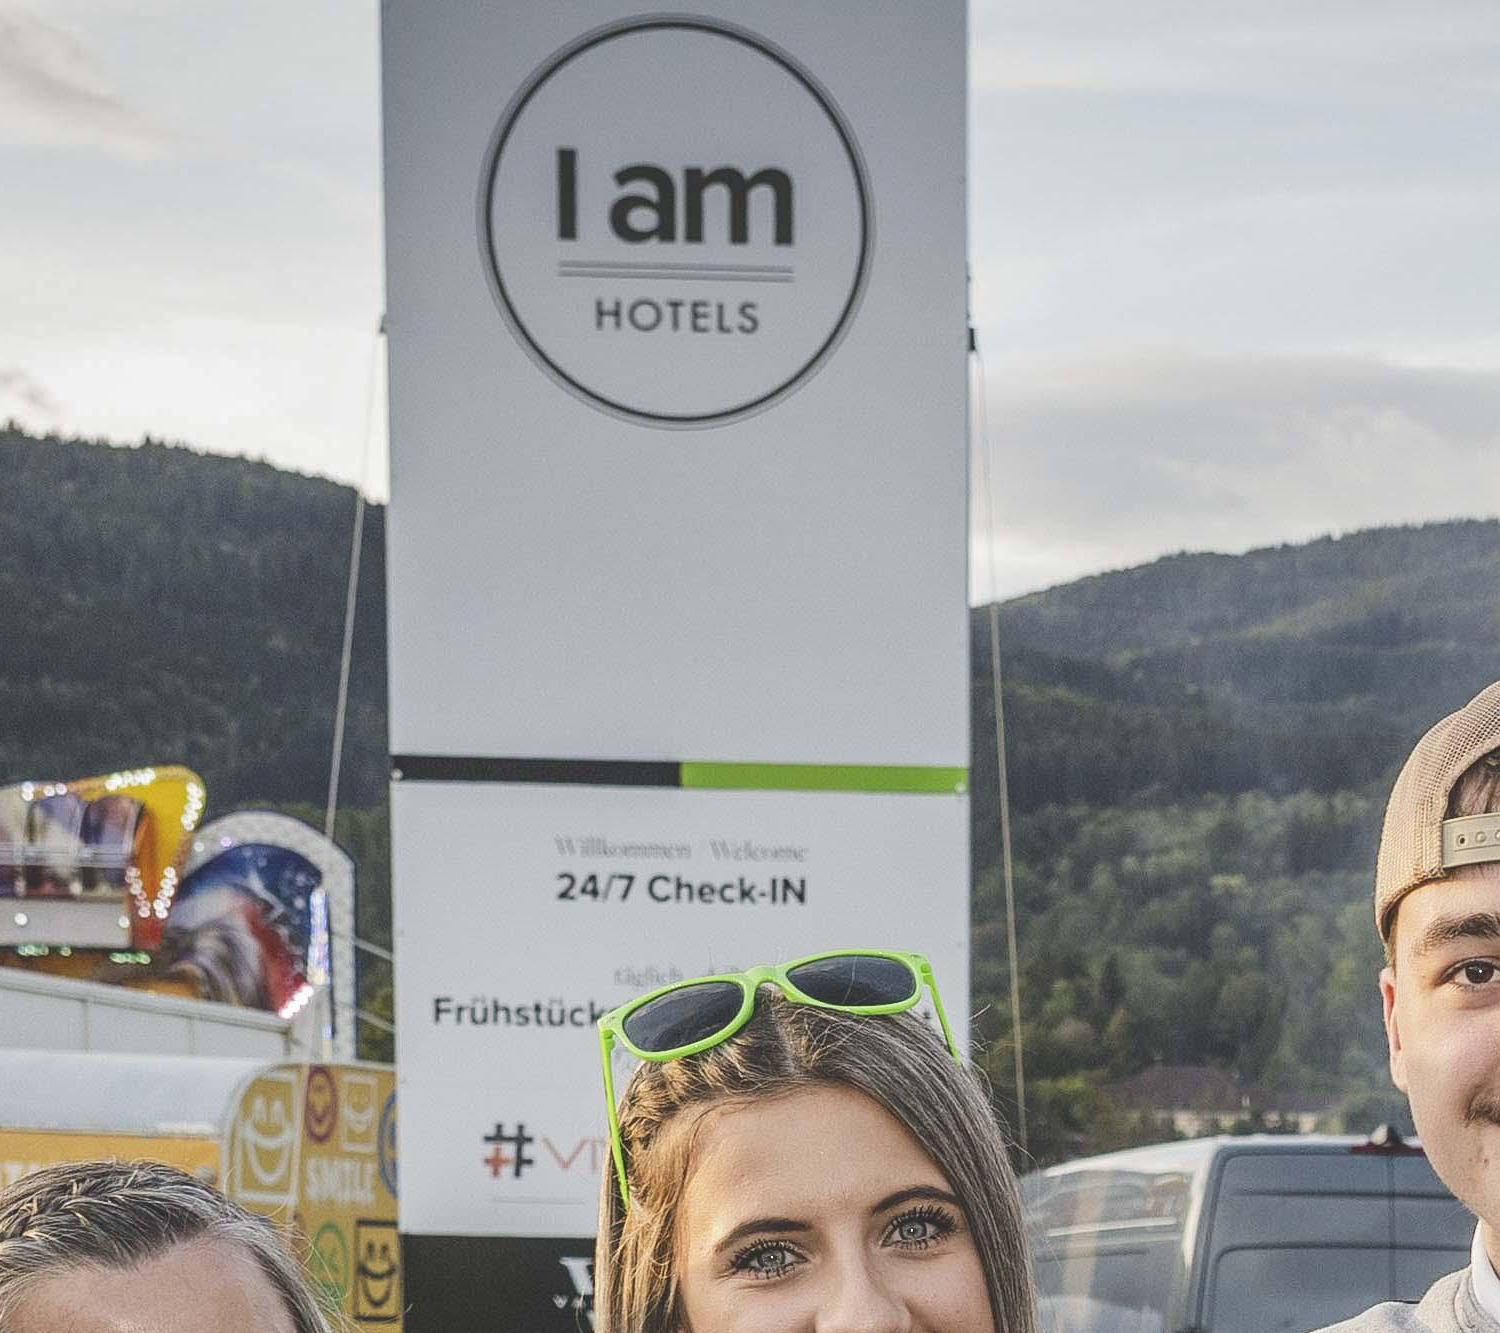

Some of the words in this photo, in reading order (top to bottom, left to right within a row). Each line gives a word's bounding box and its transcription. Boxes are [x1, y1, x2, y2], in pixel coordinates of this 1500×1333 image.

[557, 147, 577, 241] I
[609, 163, 794, 247] am
[595, 298, 760, 335] HOTELS
[554, 832, 693, 860] Willkommen
[708, 838, 808, 862] Welcome
[556, 872, 635, 902] 24/7
[647, 874, 807, 905] Check-IN
